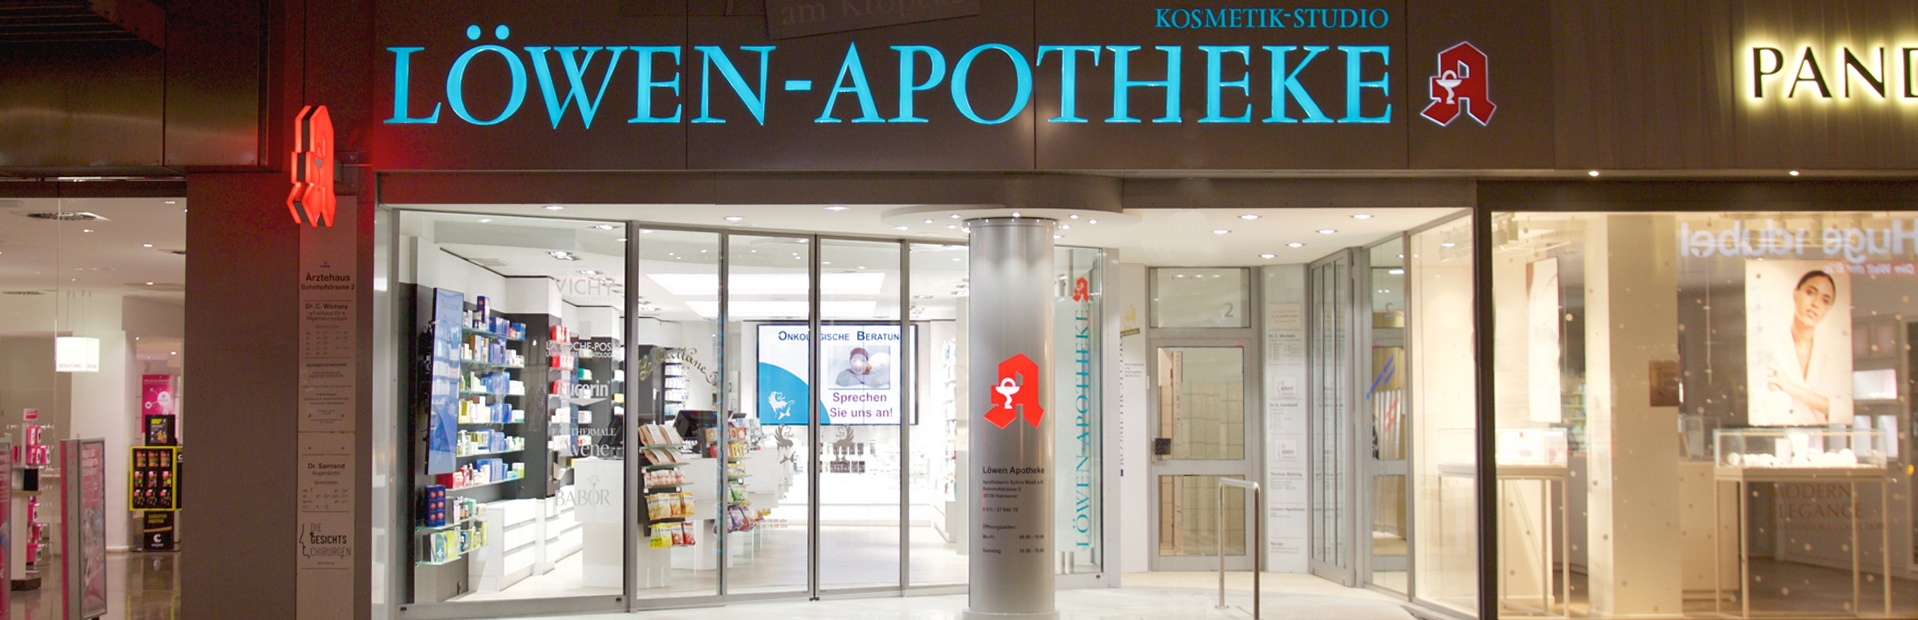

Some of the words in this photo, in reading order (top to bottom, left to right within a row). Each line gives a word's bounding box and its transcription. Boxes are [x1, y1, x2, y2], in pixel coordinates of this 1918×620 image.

[1155, 8, 1390, 29] KOSMETIK-STUDIO
[384, 24, 1393, 128] LÖWEN-APOTHEKE
[555, 278, 615, 297] VICHY
[1223, 303, 1235, 318] 2
[856, 330, 901, 342] BERATUN
[832, 392, 888, 404] Sprechen
[829, 407, 848, 418] Sie
[850, 409, 872, 418] uns
[875, 407, 893, 418] an!
[571, 427, 617, 437] THERMALE
[1072, 309, 1090, 548] LÖWEN-APOTHEKE
[318, 462, 346, 470] Samland
[982, 466, 1008, 475] Löwen
[1009, 466, 1045, 476] Apotheke
[555, 489, 611, 508] BABOR
[310, 534, 348, 545] GESICHTS
